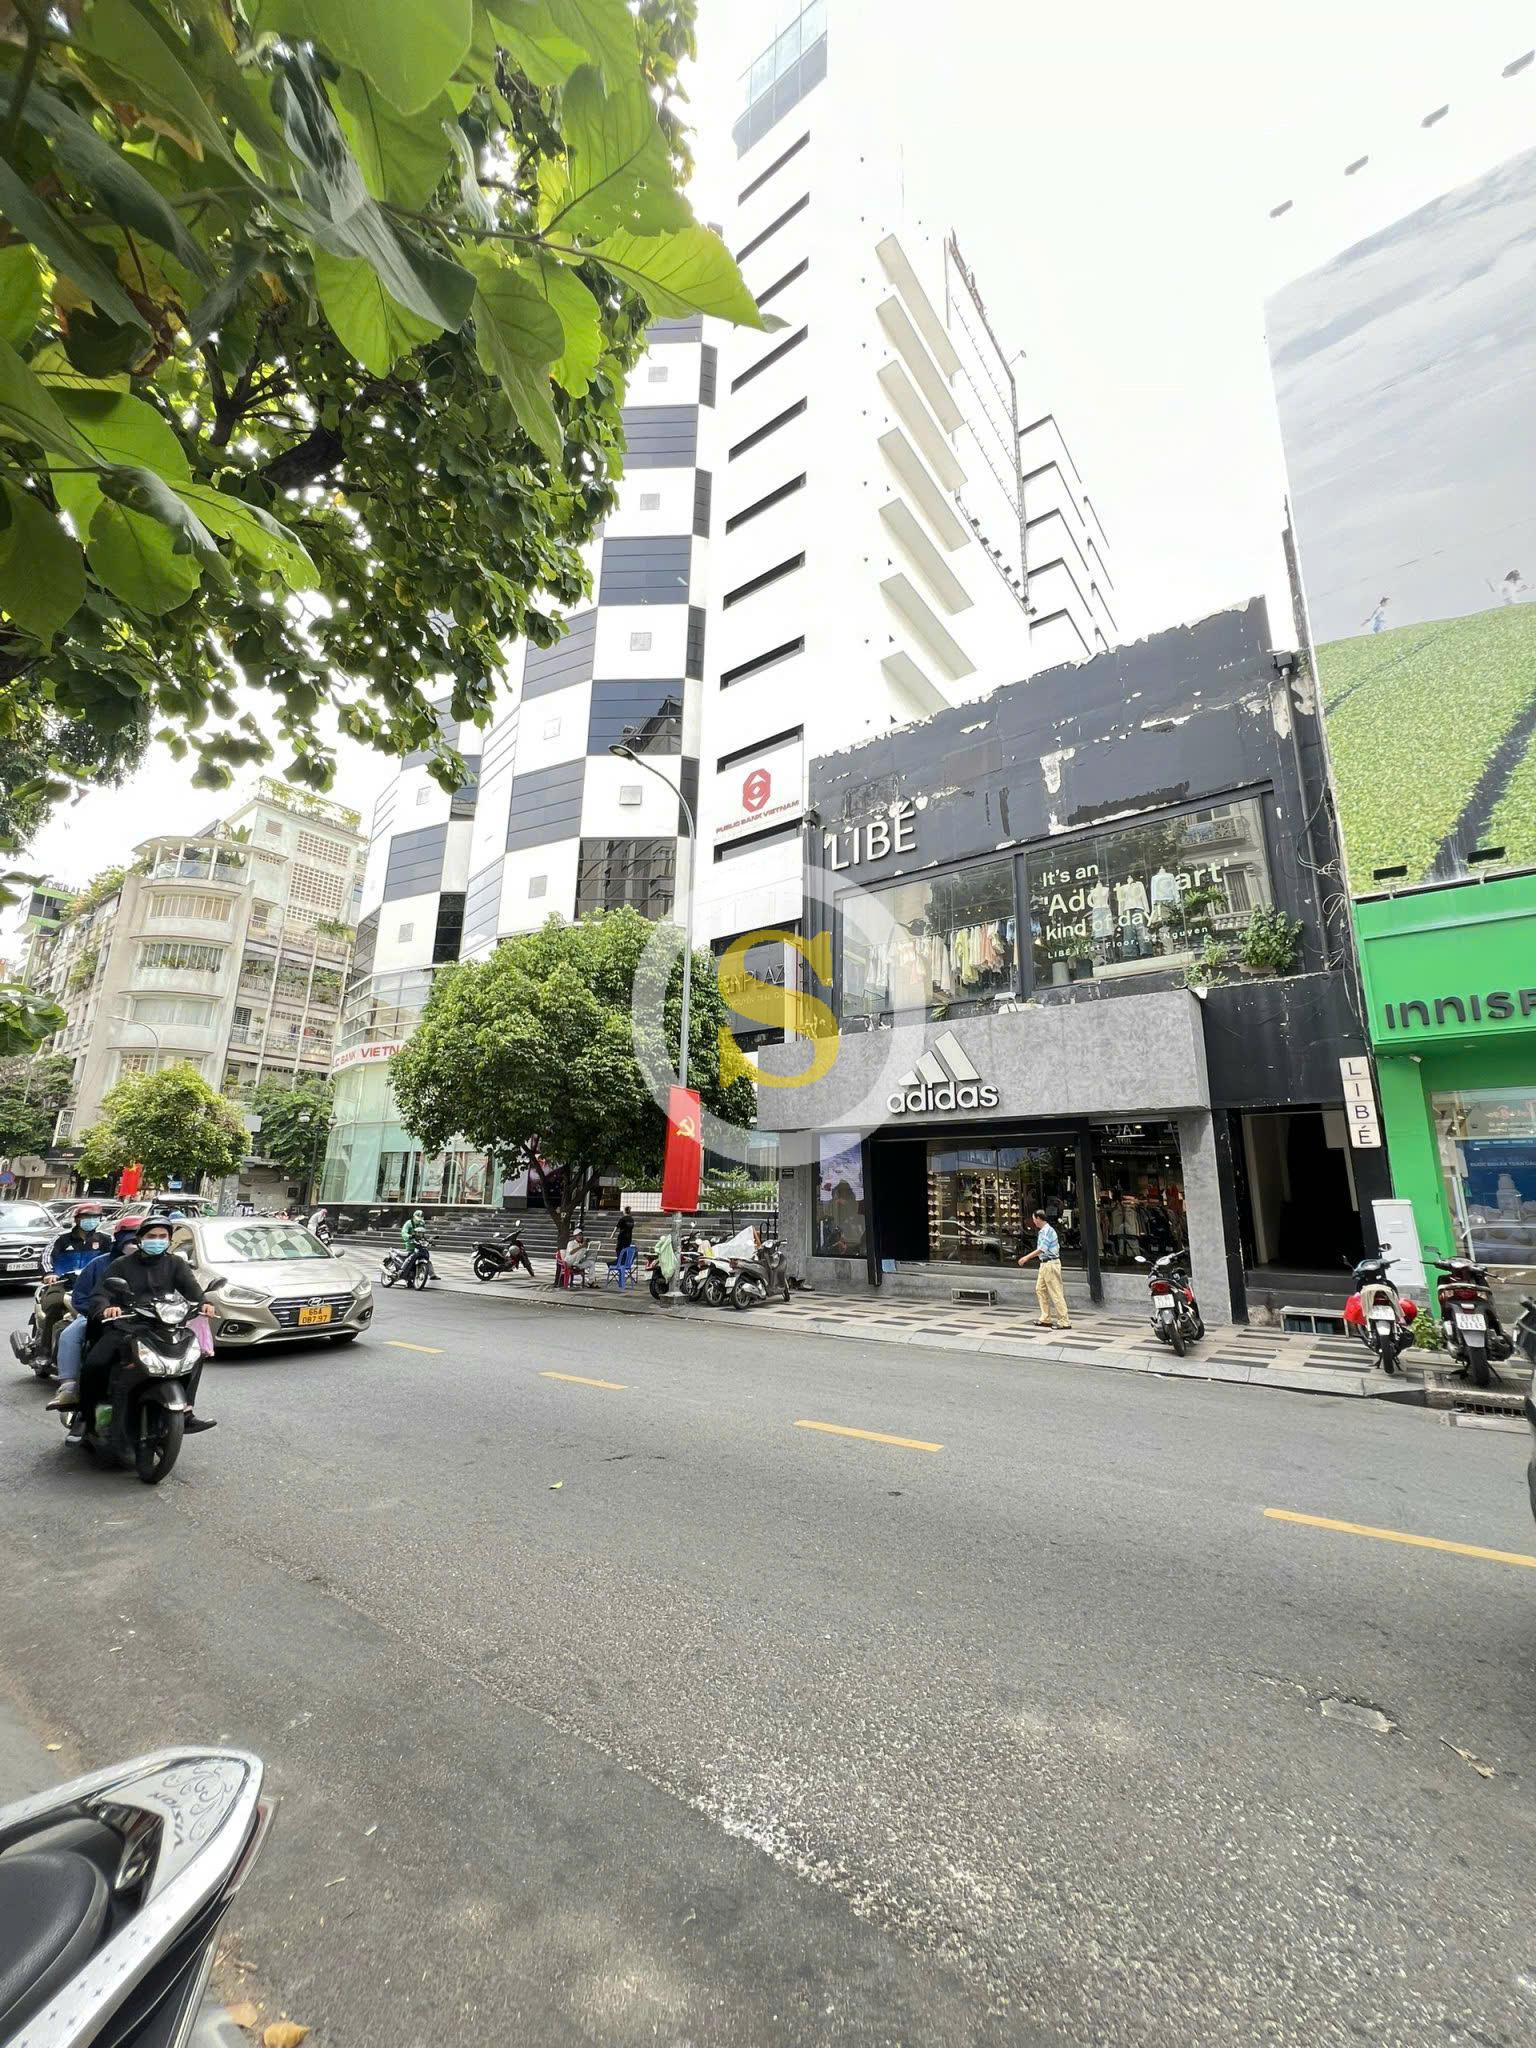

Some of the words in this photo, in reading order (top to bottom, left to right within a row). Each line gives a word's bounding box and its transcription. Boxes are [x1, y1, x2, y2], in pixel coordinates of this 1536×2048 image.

[1075, 864, 1099, 880] an
[1046, 918, 1087, 941] kind
[886, 1080, 999, 1115] adidas
[1347, 1062, 1373, 1145] LIBÉ
